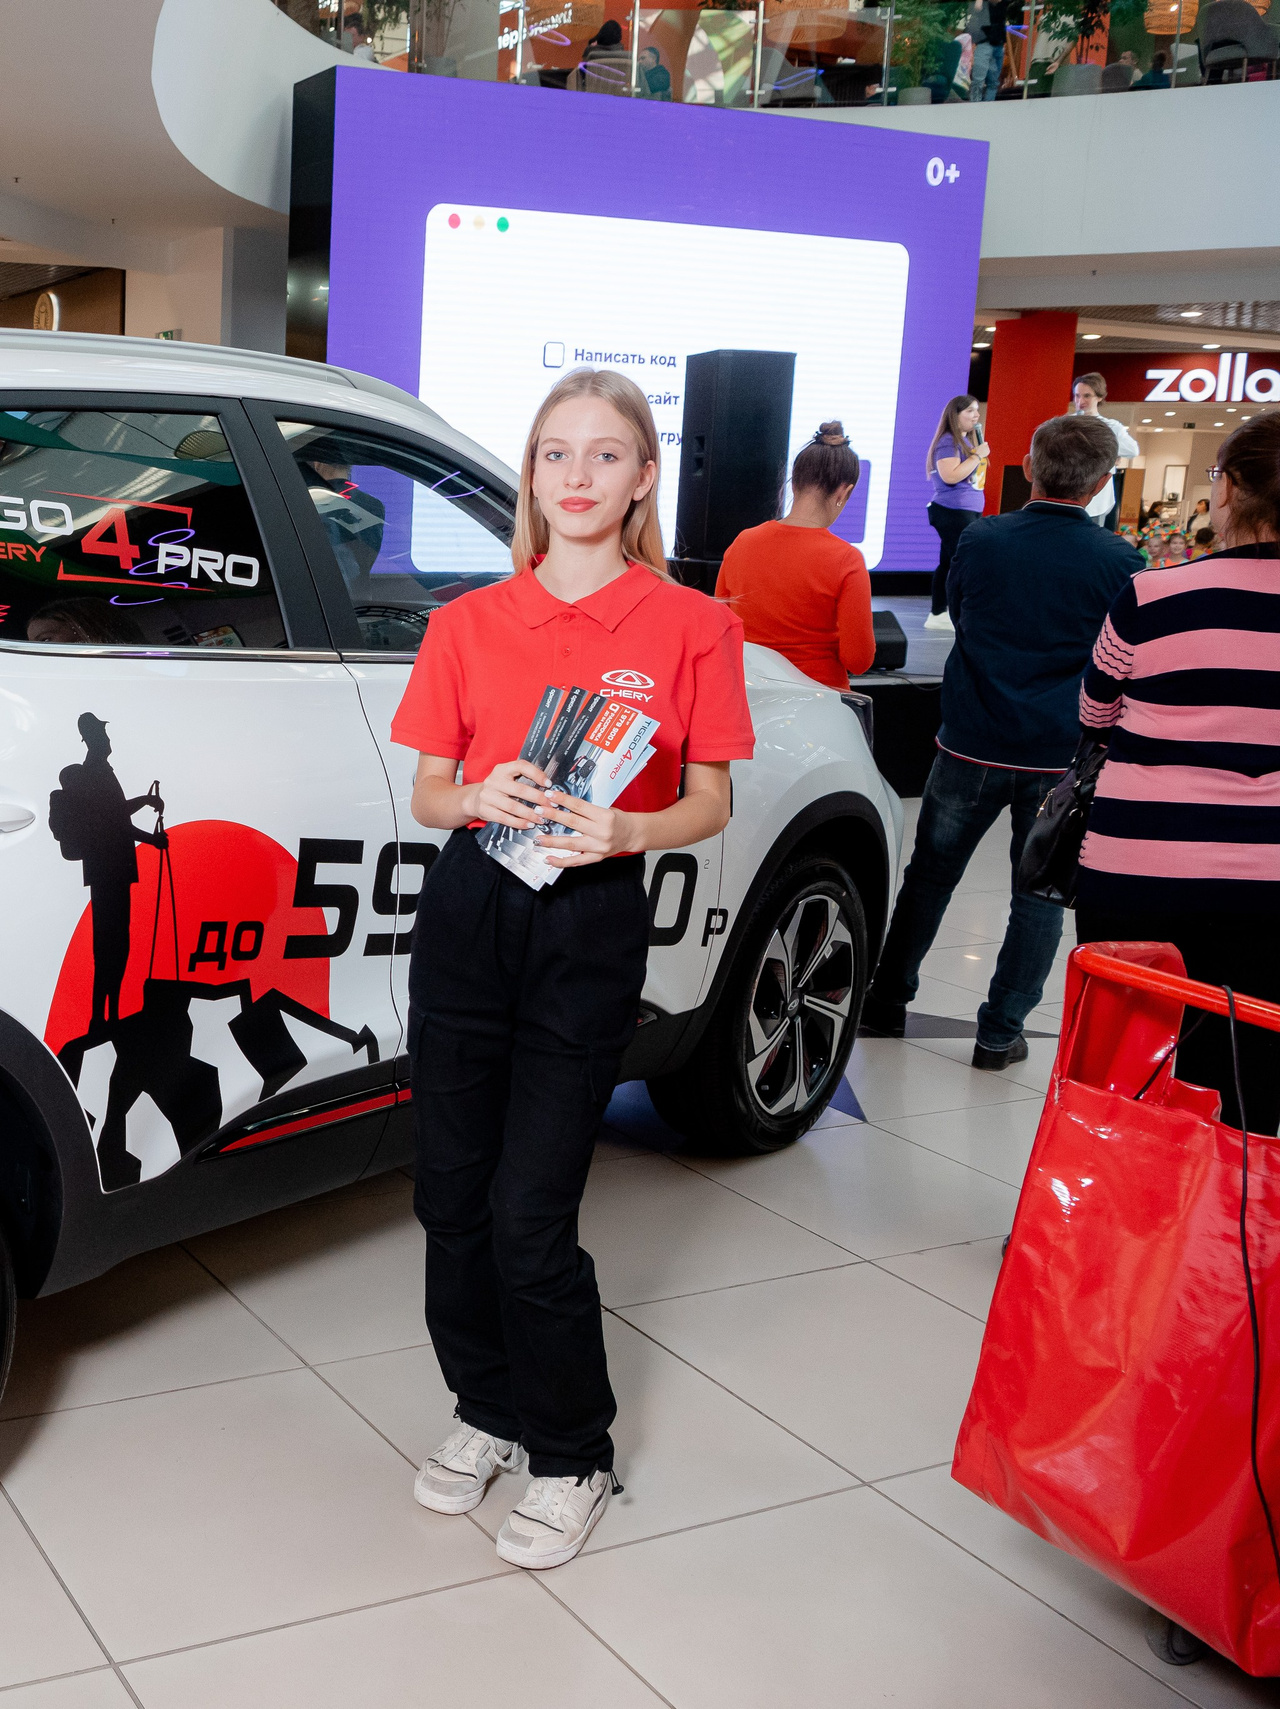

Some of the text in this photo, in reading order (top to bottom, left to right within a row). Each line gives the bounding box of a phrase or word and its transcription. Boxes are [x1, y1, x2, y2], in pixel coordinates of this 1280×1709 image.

[926, 157, 960, 187] 0+
[574, 348, 677, 368] Написать код
[1143, 352, 1280, 403] zolla
[647, 391, 680, 406] сайт
[81, 507, 140, 570] 4
[157, 543, 260, 587] PRO
[599, 688, 654, 703] CHERY
